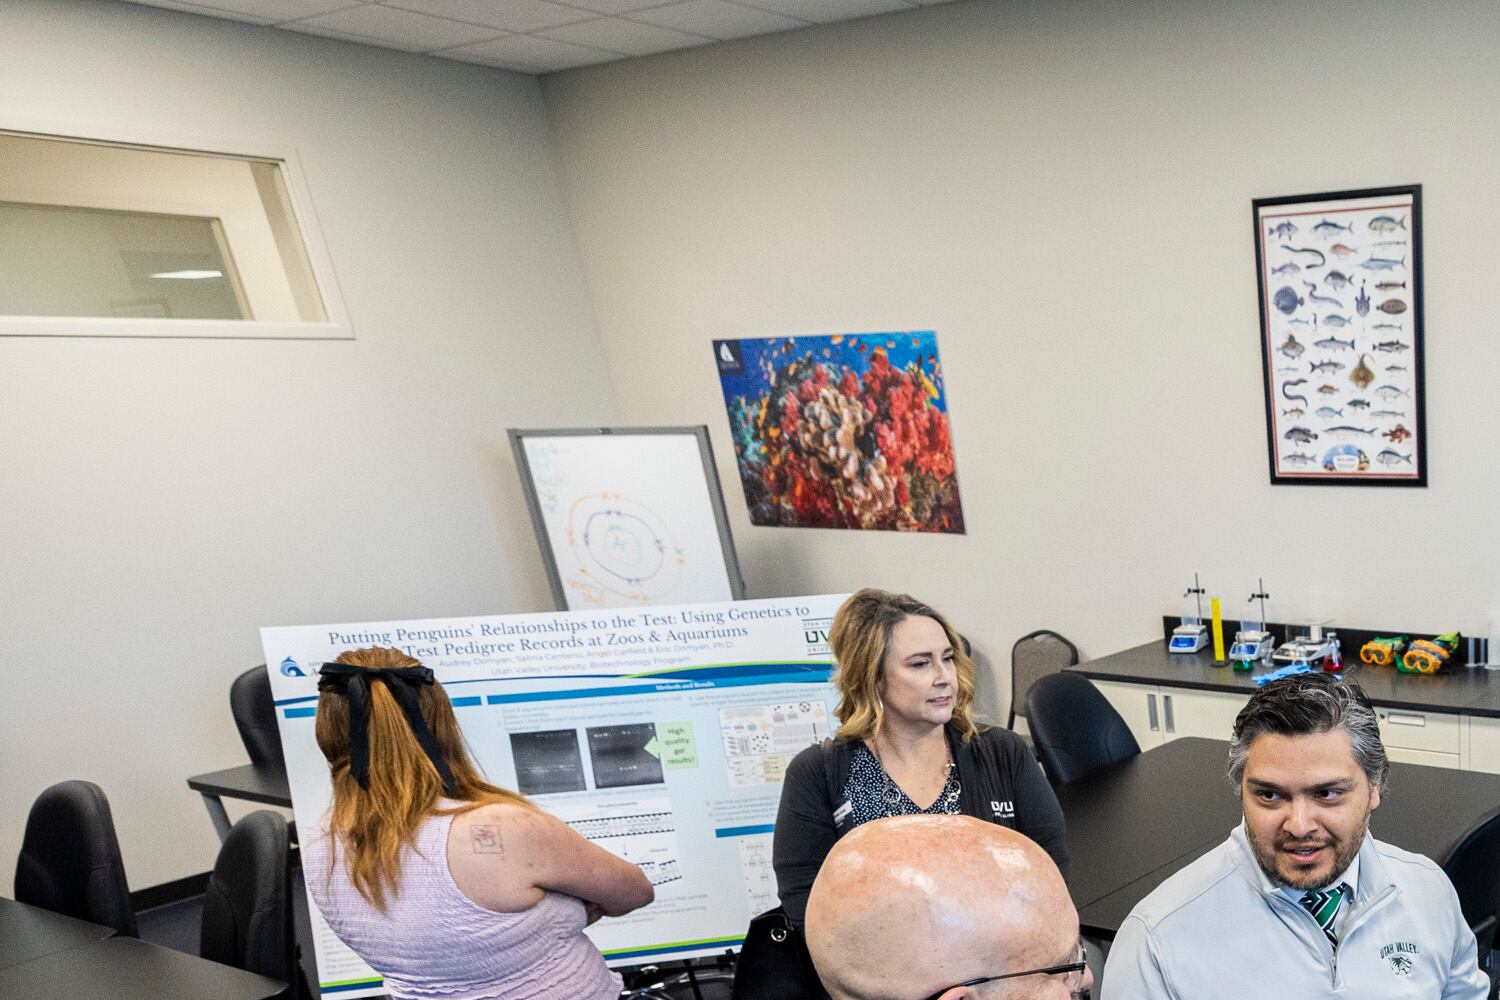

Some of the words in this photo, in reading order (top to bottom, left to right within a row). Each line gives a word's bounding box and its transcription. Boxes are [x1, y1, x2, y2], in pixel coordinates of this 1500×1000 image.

[328, 630, 391, 645] Putting
[396, 624, 473, 642] Penguins'
[480, 619, 587, 636] Relationships
[591, 620, 607, 629] to
[611, 615, 635, 628] the
[639, 614, 676, 626] Test:
[681, 610, 725, 624] Using
[728, 606, 791, 620] Genetics
[795, 607, 809, 616] to
[805, 630, 829, 644] UV
[405, 645, 438, 659] Test
[444, 641, 514, 656] Pedigree
[519, 635, 584, 651] Records
[588, 636, 601, 646] at
[606, 633, 644, 645] Zoos
[649, 630, 660, 642] &
[667, 626, 748, 643] Aquariums
[1380, 944, 1394, 959] UTAH
[1395, 942, 1417, 954] VALLEY
